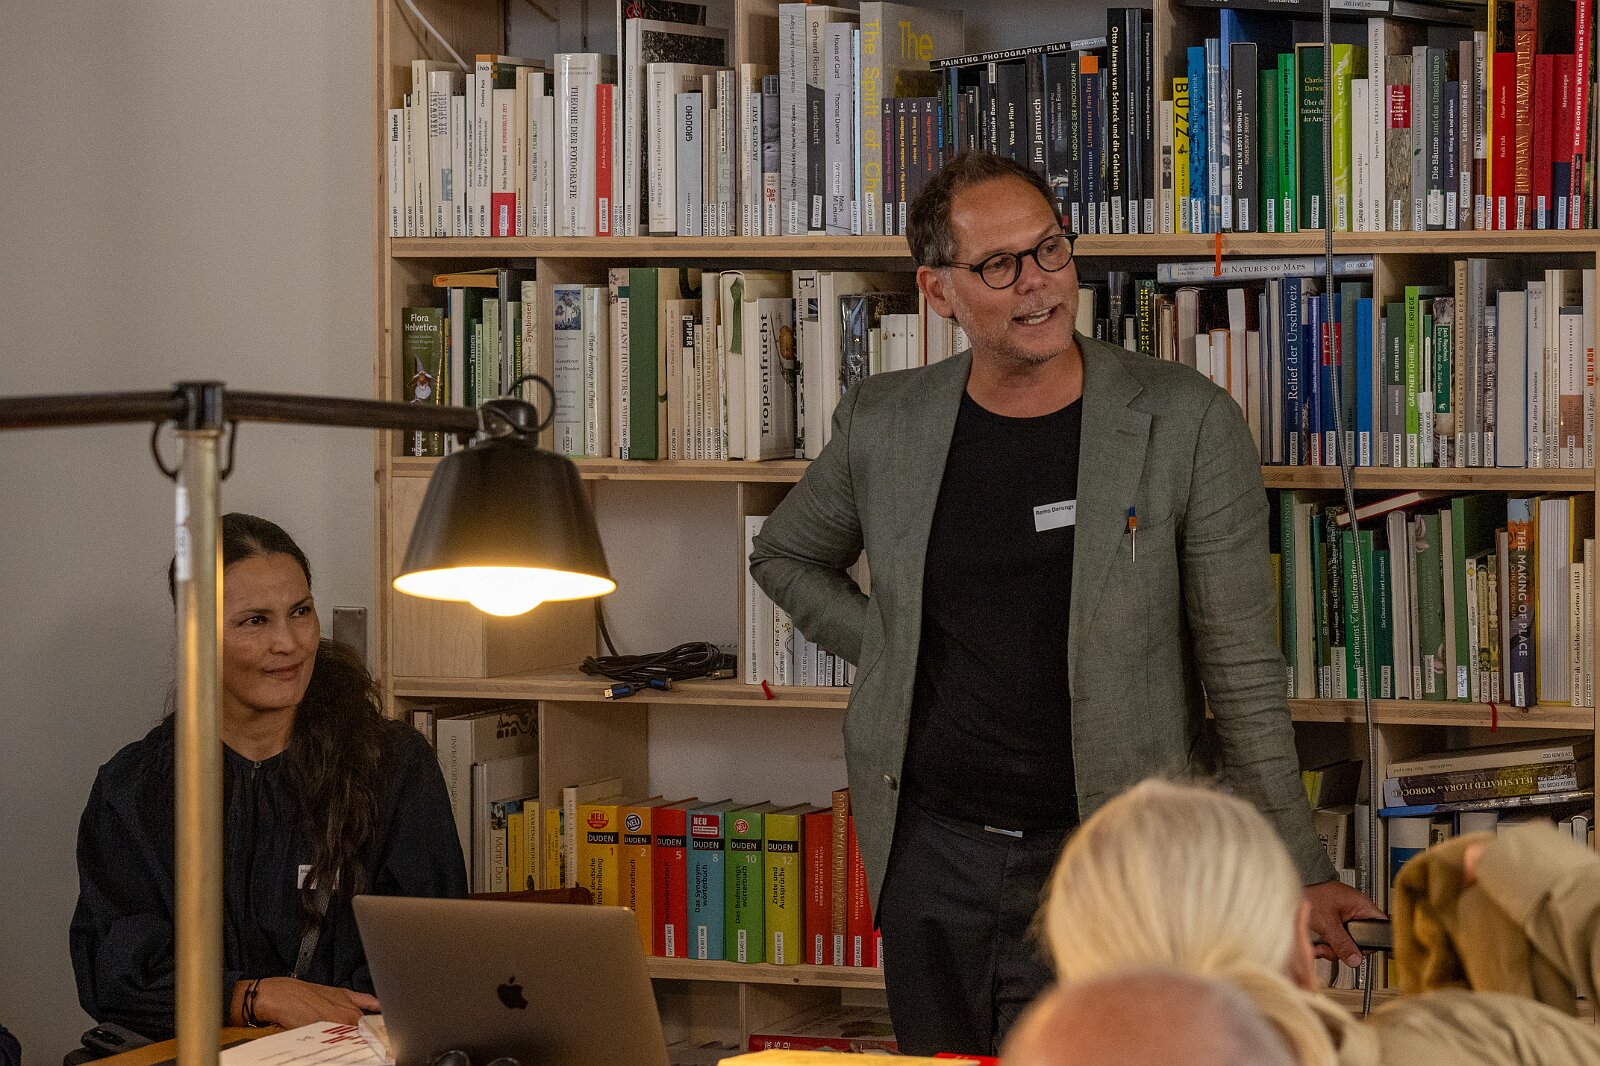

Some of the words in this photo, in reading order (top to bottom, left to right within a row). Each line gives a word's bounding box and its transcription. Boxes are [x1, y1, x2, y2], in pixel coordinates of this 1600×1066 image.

[812, 21, 820, 55] Gerhard
[864, 18, 880, 54] The
[898, 20, 934, 61] The
[1111, 26, 1120, 44] Otto
[940, 56, 979, 67] PAINTING
[982, 46, 1044, 62] PHOTOGRAPHY
[1046, 42, 1067, 53] FILM
[1111, 45, 1120, 76] Marseus
[812, 56, 820, 85] Richter
[1431, 55, 1440, 103] Unsichtbare
[1475, 57, 1483, 102] PHÄNOMEN
[1576, 54, 1585, 85] WÄLDER
[862, 67, 881, 117] Spirit
[1070, 62, 1078, 108] PHOTOGRAPHIE
[1111, 77, 1120, 91] van
[1461, 80, 1469, 99] Ende
[430, 91, 440, 138] TARKOWSKIJ
[438, 93, 448, 120] SPIEGEL
[569, 85, 579, 125] THEORIE
[752, 106, 760, 124] TATI
[834, 93, 842, 117] Thomas
[1008, 103, 1016, 120] Film?
[1070, 109, 1078, 120] DER
[1111, 92, 1120, 123] Schrieck
[1175, 83, 1189, 139] BUZZ
[1431, 104, 1440, 119] das
[1461, 101, 1469, 119] ohne
[1575, 87, 1583, 131] SCHÖNSTEN
[438, 122, 448, 135] DER
[685, 105, 693, 142] GROUCHO
[812, 100, 821, 145] Landschaft
[834, 118, 842, 145] Demand
[1008, 121, 1016, 129] ist
[1033, 99, 1044, 144] Jarmusch
[1111, 124, 1120, 139] und
[1431, 119, 1440, 136] und
[1461, 120, 1469, 142] Leben
[1475, 104, 1483, 152] HONIGBIENE
[569, 126, 579, 144] DER
[752, 126, 760, 162] JACQUES
[864, 130, 880, 148] of
[1008, 131, 1016, 146] Was
[1070, 121, 1078, 161] RANDGÄNGE
[1111, 140, 1120, 152] die
[1033, 146, 1044, 164] Jim
[1431, 137, 1440, 165] Bäume
[569, 146, 579, 199] FOTOGRAFIE
[1111, 153, 1120, 190] Gelehrten
[1431, 166, 1440, 180] Die
[838, 196, 846, 213] Mack
[1232, 265, 1269, 273] NATURES
[1284, 263, 1306, 271] MAPS
[410, 314, 429, 322] Flora
[620, 300, 628, 320] THE
[1141, 289, 1150, 339] PFLANZEN
[1287, 284, 1299, 343] Urschweiz
[1407, 295, 1416, 321] KRIEGE
[404, 323, 438, 332] Helvetica
[525, 302, 533, 343] Symbiosen
[1407, 322, 1416, 343] KEINE
[1476, 321, 1484, 345] BROWN
[620, 321, 628, 351] PLANT
[1287, 345, 1299, 364] der
[1407, 344, 1416, 373] FÜHREN
[620, 353, 628, 396] HUNTERS
[761, 313, 769, 437] Tropenfrucht
[1587, 364, 1594, 372] DI
[1287, 366, 1299, 400] Relief
[1407, 374, 1416, 407] GÄRTNER
[1486, 379, 1494, 396] LUCY
[1486, 403, 1494, 429] LIPPARD
[1051, 504, 1074, 513] Derungs
[1518, 530, 1528, 551] THE
[1518, 555, 1528, 601] MAKING
[1518, 605, 1528, 620] OF
[1352, 624, 1361, 670] Gartenkunst
[1518, 622, 1528, 657] PLACE
[1444, 782, 1473, 792] FLORA
[1475, 775, 1534, 791] ILLUSTRATED
[627, 819, 639, 827] NEU
[693, 817, 707, 825] NEU
[493, 836, 504, 865] Monty
[610, 848, 614, 856] 1
[676, 851, 681, 859] 5
[693, 841, 719, 849] DUDEN
[732, 841, 757, 849] DUDEN
[769, 843, 793, 851] DUDEN
[712, 854, 718, 862] 8
[746, 855, 756, 863] 10
[783, 857, 793, 865] 12
[495, 866, 503, 885] Don
[694, 862, 702, 898] Synonym-
[734, 863, 742, 909] Bedeutungs-
[694, 899, 702, 913] Das
[734, 910, 742, 924] Das
